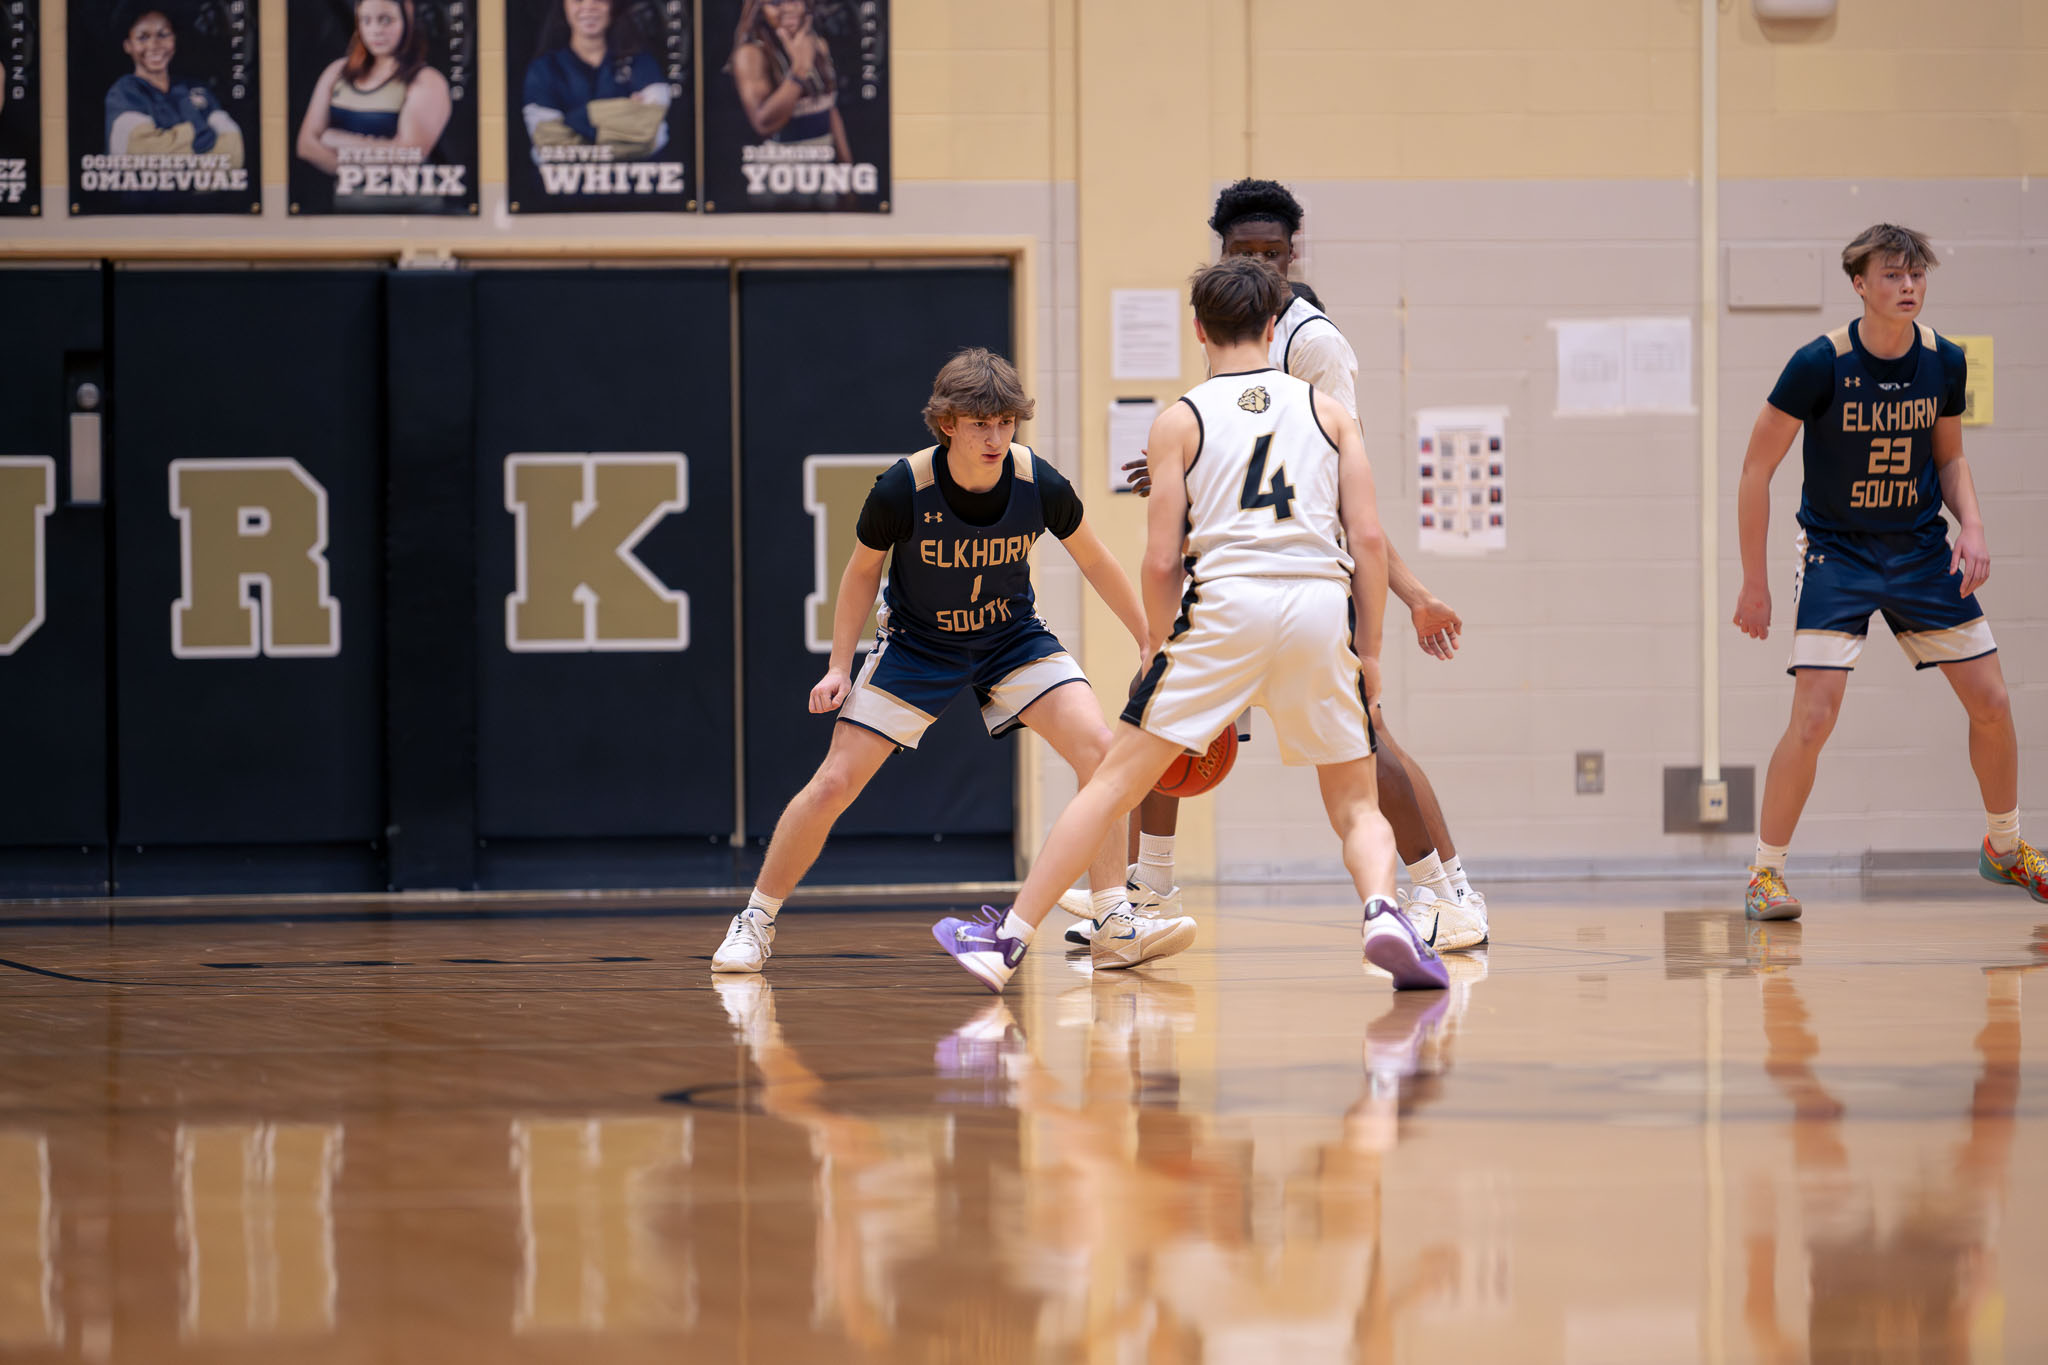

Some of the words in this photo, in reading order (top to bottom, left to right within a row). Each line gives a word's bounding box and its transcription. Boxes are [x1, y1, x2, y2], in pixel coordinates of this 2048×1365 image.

[81, 169, 248, 191] OMADEVUAE
[337, 164, 467, 195] PENIX
[539, 163, 684, 194] WHITE
[742, 163, 878, 193] YOUNG
[1842, 397, 1938, 432] ELKHORN
[1867, 437, 1912, 475] 23
[1238, 432, 1295, 522] 4
[1850, 477, 1917, 508] SOUTH
[920, 531, 1036, 568] ELKHORN
[970, 574, 983, 603] 1
[936, 597, 1012, 632] SOUTH
